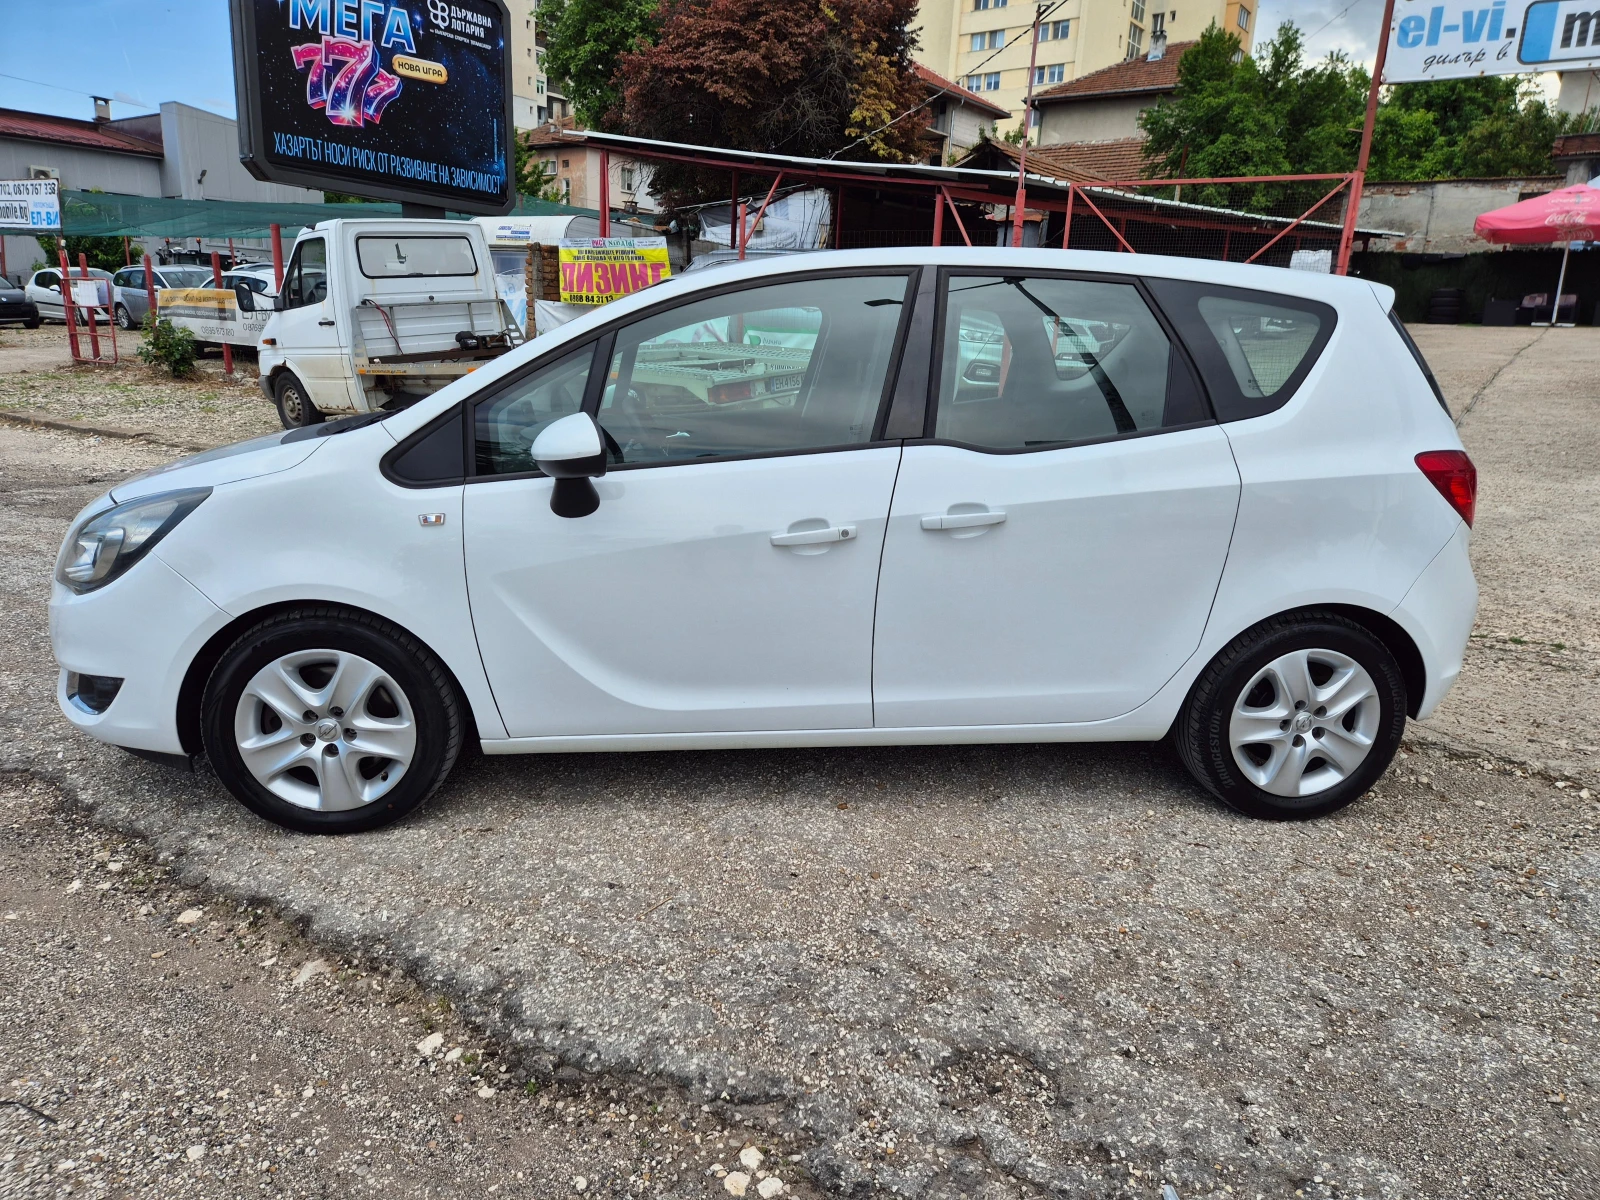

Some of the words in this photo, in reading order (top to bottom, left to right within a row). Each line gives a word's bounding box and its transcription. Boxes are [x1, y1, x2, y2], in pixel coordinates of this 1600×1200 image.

[289, 0, 417, 53] МЕГА
[450, 5, 492, 28] ДЪРЖАВНА
[451, 18, 485, 38] ЛОТАРИЯ
[397, 60, 421, 74] НОВА
[422, 66, 443, 78] ИГРА
[1422, 48, 1486, 73] дилър
[1496, 40, 1513, 61] в
[290, 35, 403, 127] 777
[273, 131, 323, 161] ХАЗАРТЪТ
[324, 141, 351, 167] НОСИ
[352, 146, 377, 171] РИСК
[377, 151, 389, 173] ОТ
[390, 154, 438, 183] РАЗВИВАНЕ
[438, 164, 451, 185] НА
[451, 166, 501, 194] ЗАВИСИМОСТ
[31, 211, 59, 226] ЕЛ-ВИ
[562, 262, 666, 295] ЛИЗИНГ
[585, 295, 595, 303] 84
[1208, 708, 1236, 789] BRIDGESTONE
